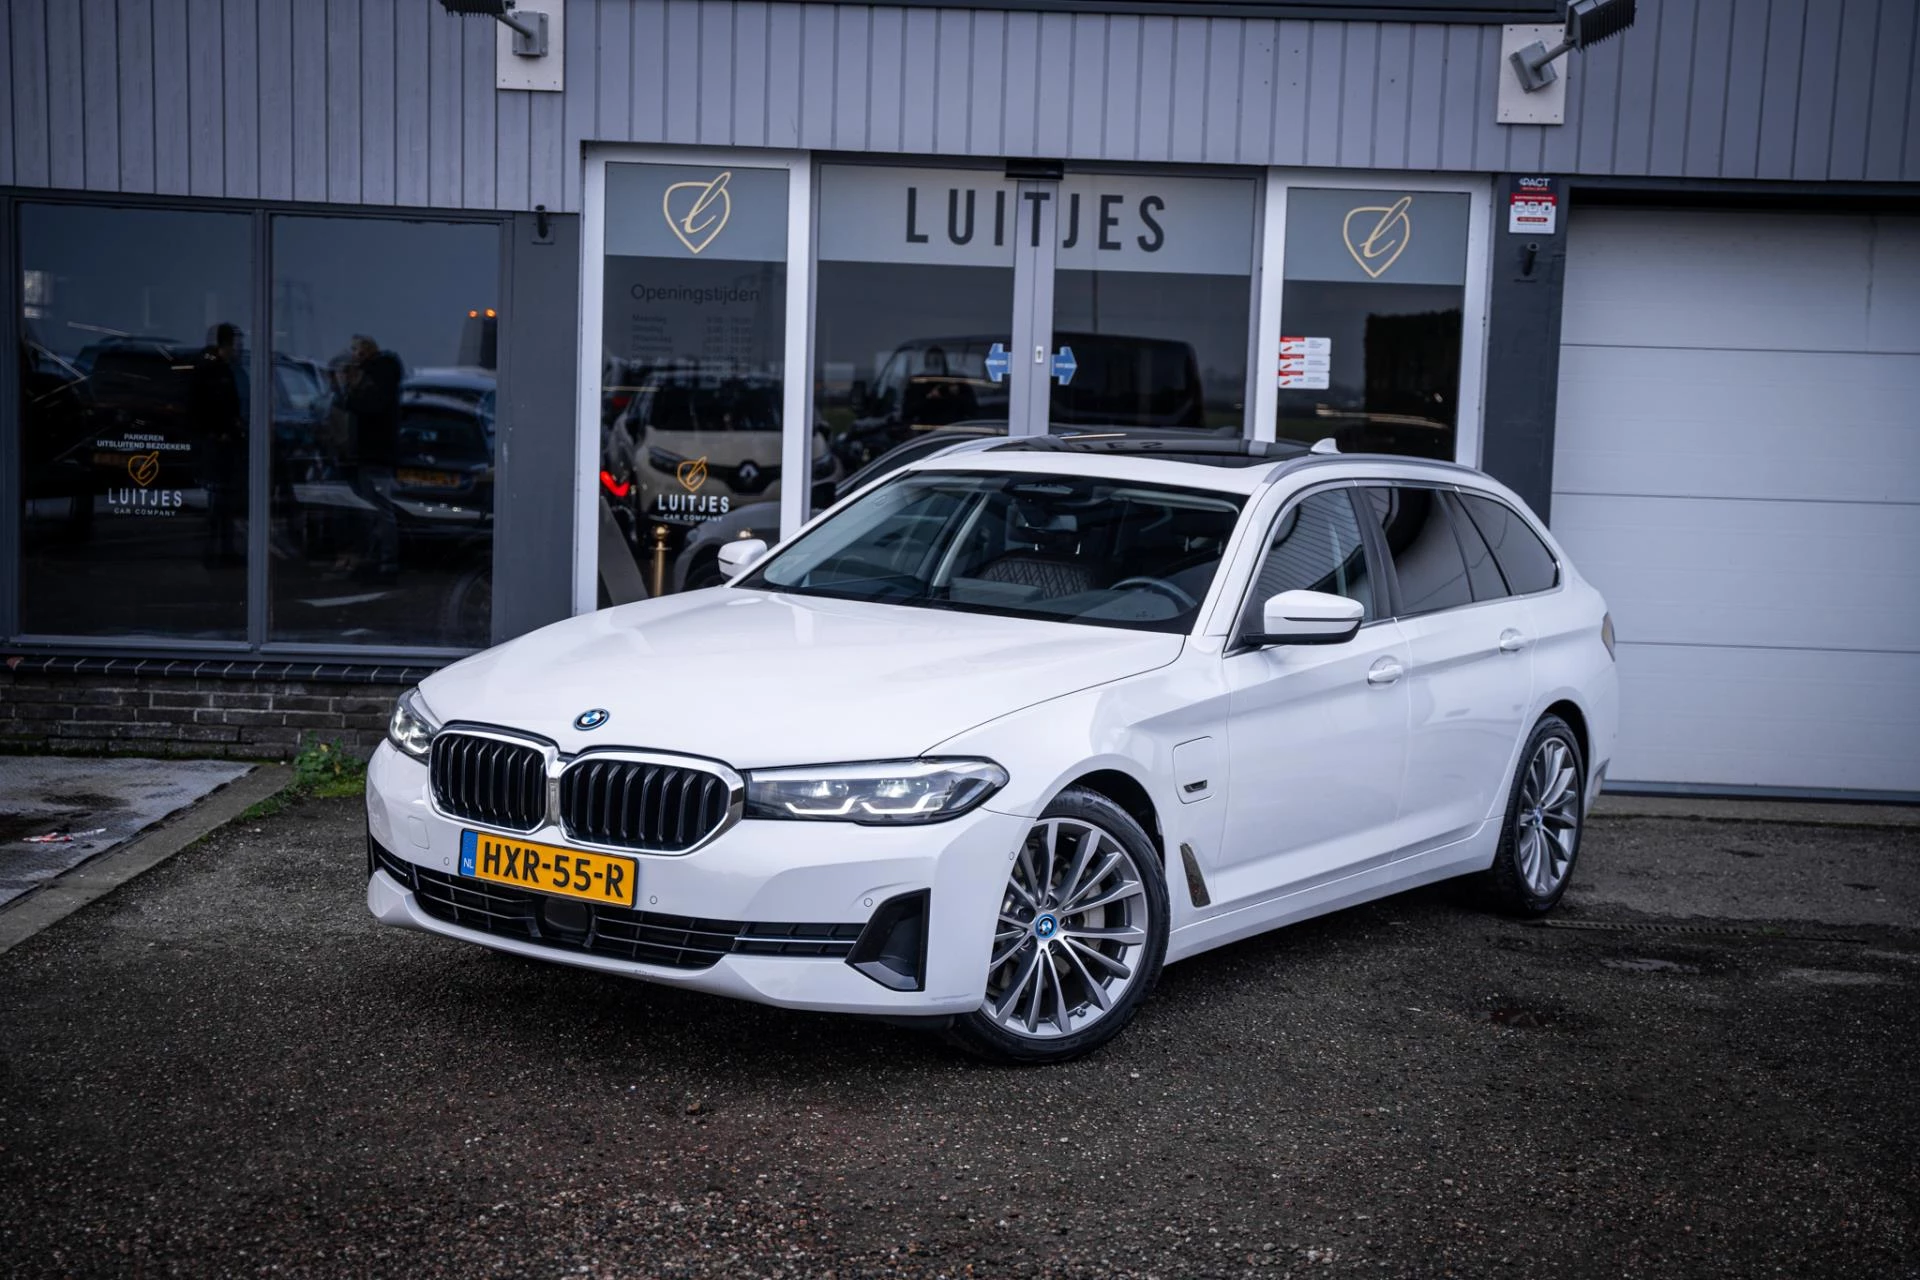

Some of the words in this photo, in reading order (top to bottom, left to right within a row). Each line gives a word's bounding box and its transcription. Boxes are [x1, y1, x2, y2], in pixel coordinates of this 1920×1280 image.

[906, 187, 1165, 252] LUITJES
[631, 283, 760, 305] Openingstijden
[97, 440, 145, 449] UITSLUITEND
[146, 442, 191, 451] BEZOEKERS
[124, 433, 164, 442] PARKEREN
[108, 488, 182, 507] LUITJES
[658, 494, 730, 513] LUITJES
[114, 507, 131, 515] CAR
[134, 508, 176, 517] COMPANY
[663, 513, 680, 521] CAR
[684, 514, 723, 522] COMPANY
[463, 858, 474, 869] NL
[483, 841, 624, 898] HXR-55-R
